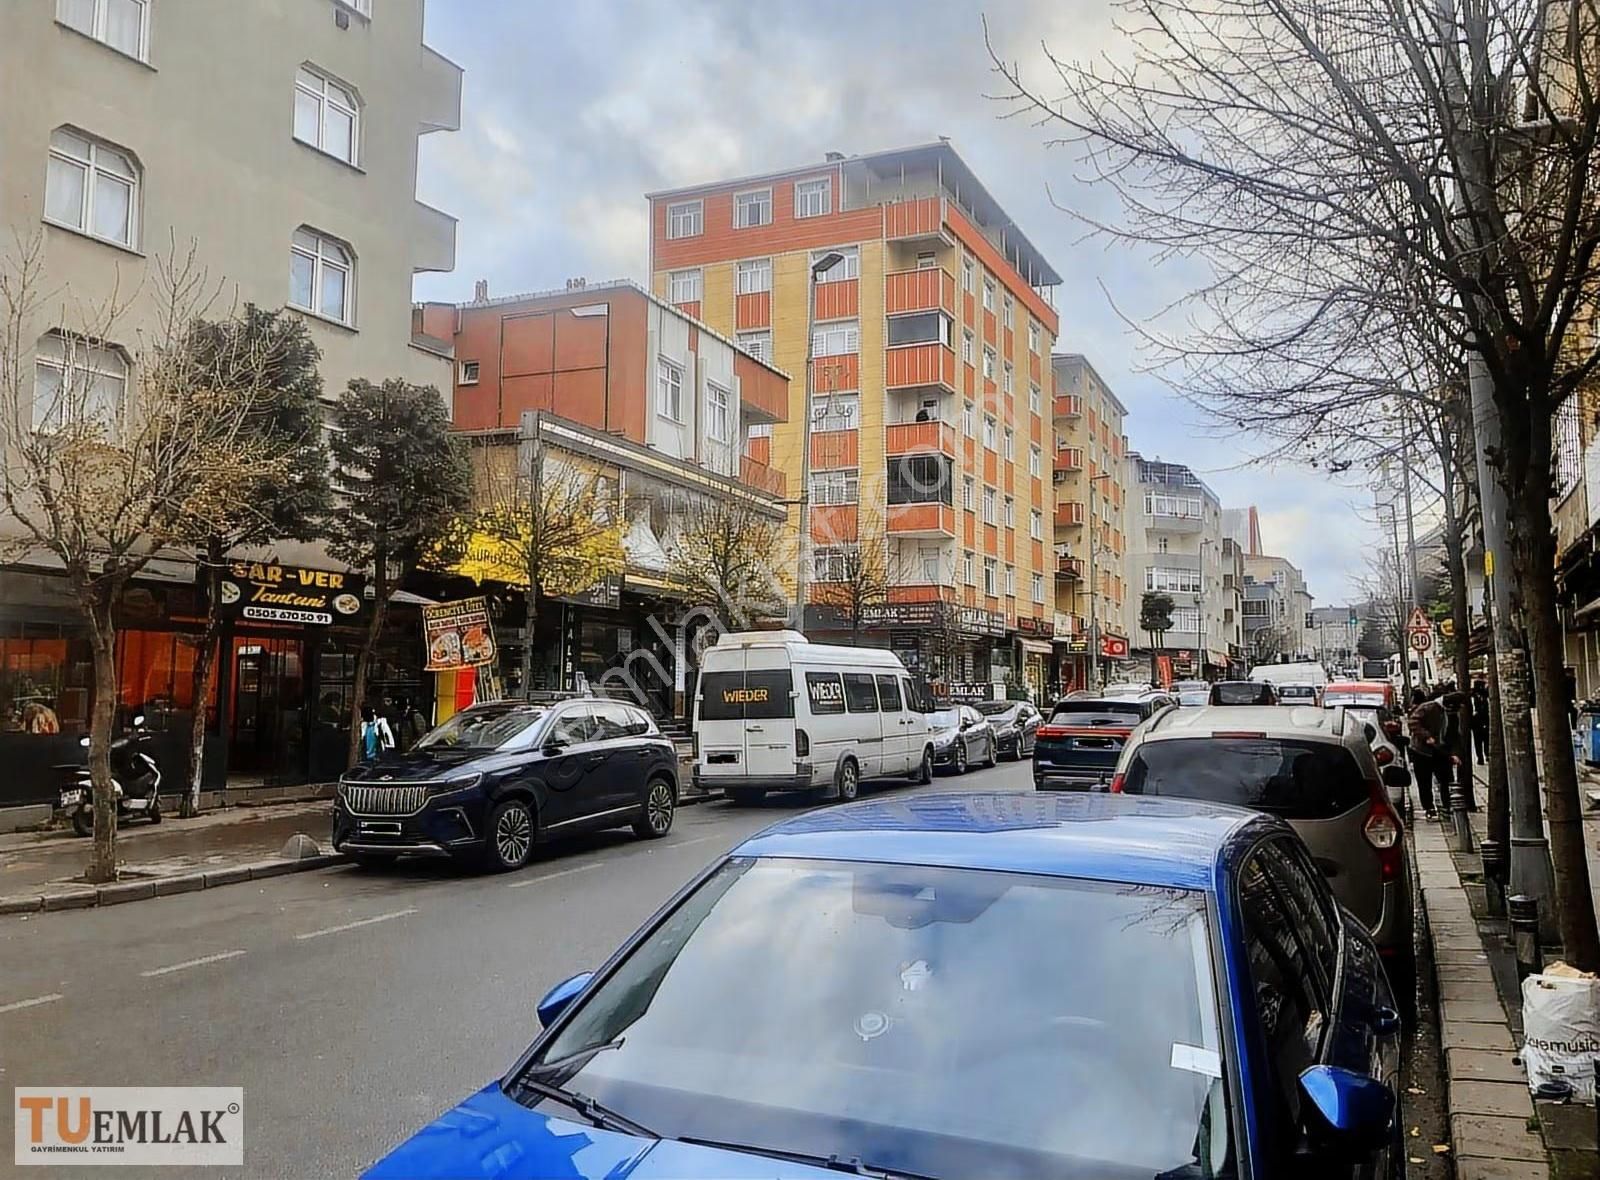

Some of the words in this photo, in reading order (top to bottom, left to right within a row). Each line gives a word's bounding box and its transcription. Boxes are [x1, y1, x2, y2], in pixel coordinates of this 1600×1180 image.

[247, 607, 277, 619] 0505
[279, 610, 299, 620] 670
[300, 612, 314, 622] 50
[316, 614, 328, 623] 91
[1414, 635, 1428, 646] 30
[723, 689, 769, 703] WIEDER
